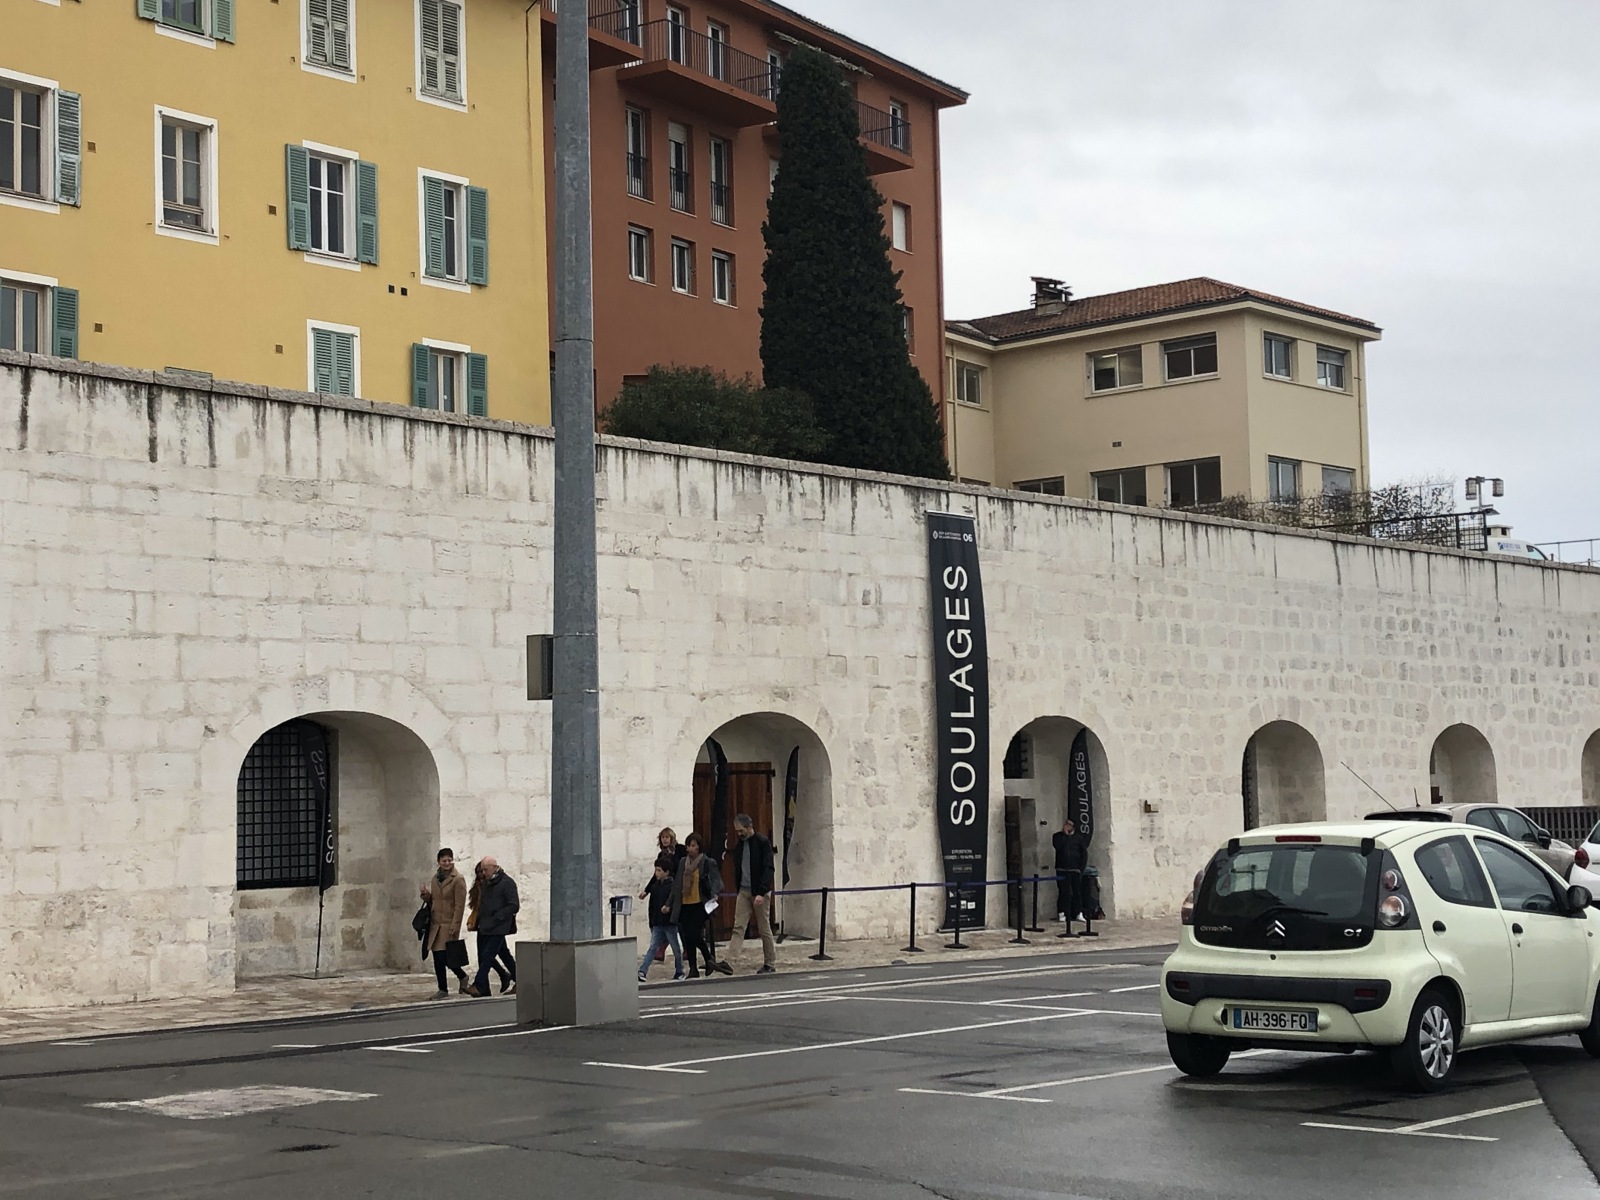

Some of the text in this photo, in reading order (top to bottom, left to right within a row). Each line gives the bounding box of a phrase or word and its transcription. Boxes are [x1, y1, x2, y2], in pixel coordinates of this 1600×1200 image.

[962, 533, 974, 543] 06
[942, 565, 977, 827] SOULAGES
[1074, 751, 1091, 835] SOULAGES
[1343, 928, 1363, 937] C1
[1243, 1011, 1308, 1029] AH-396-FQ
